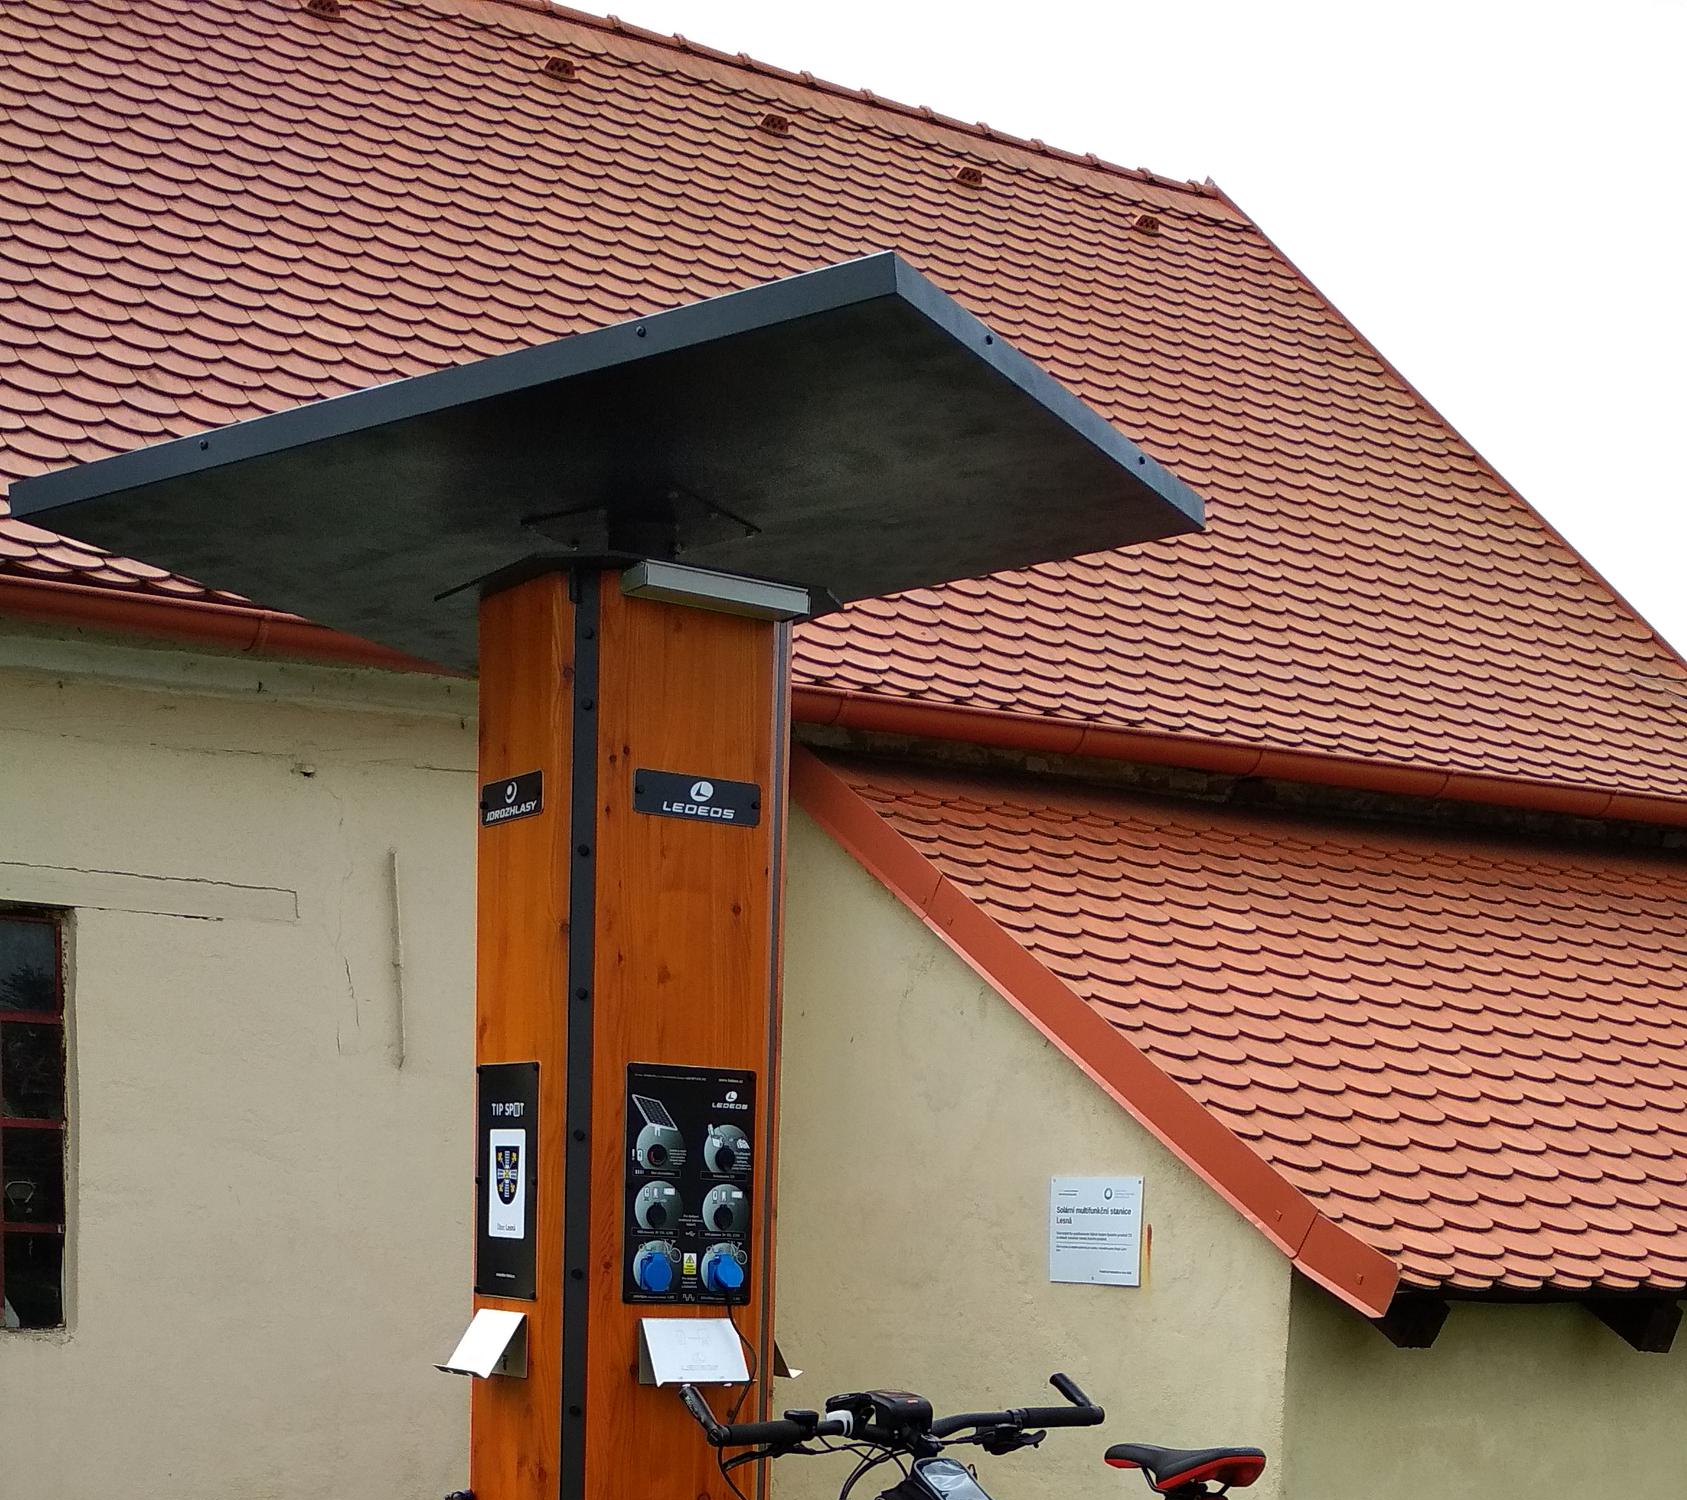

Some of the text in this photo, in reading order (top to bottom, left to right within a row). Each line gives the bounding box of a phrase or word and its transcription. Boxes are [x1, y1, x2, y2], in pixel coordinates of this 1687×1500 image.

[662, 800, 736, 819] LEDEOS
[491, 1103, 504, 1116] TIP
[712, 1102, 748, 1110] LEDEOS
[1109, 1207, 1132, 1216] stanice
[1056, 1216, 1073, 1225] Lesná
